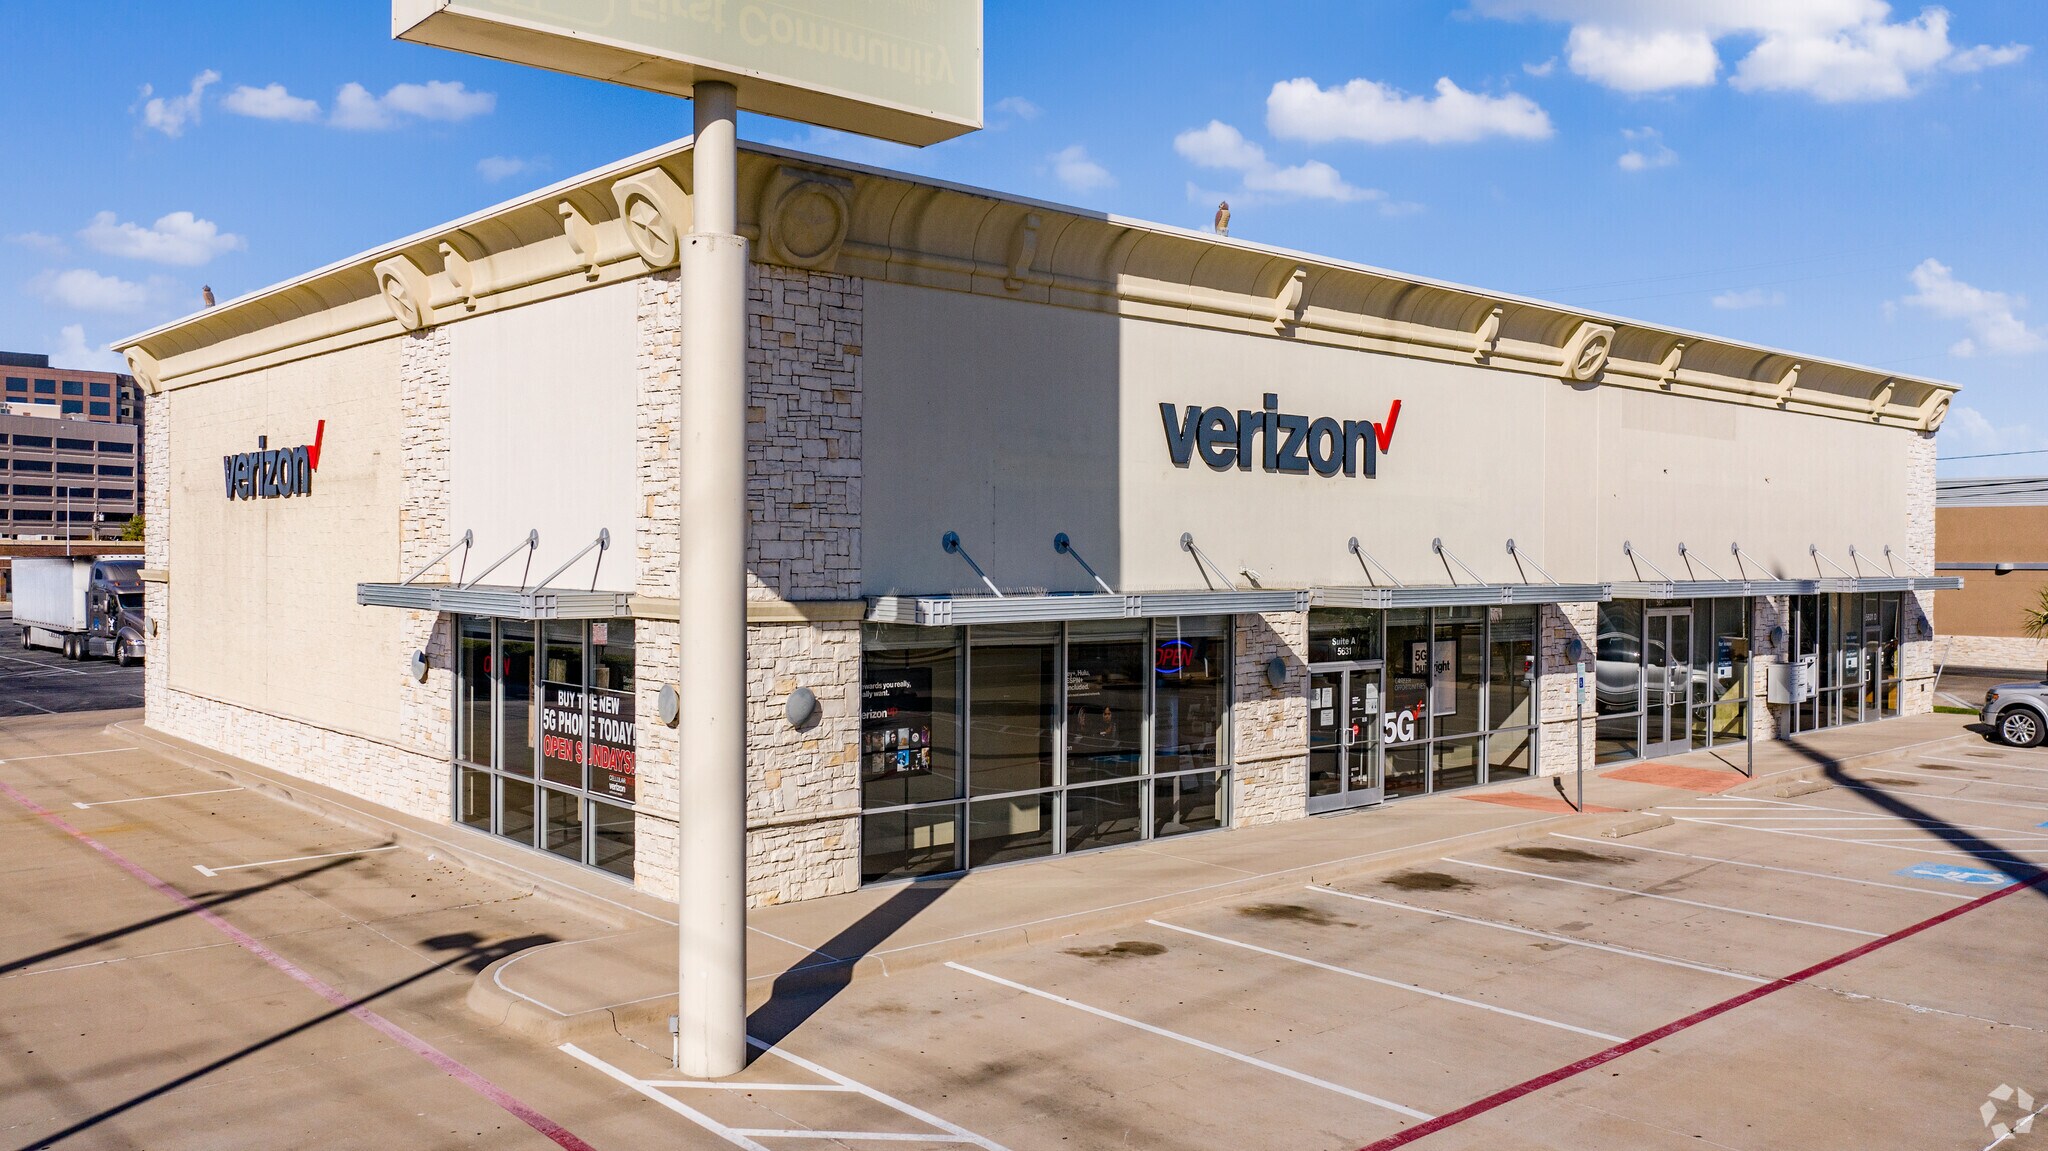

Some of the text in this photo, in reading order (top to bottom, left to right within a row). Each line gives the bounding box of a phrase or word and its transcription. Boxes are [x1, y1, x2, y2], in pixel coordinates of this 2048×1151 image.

[1159, 392, 1377, 479] verizon
[223, 435, 312, 501] verizon
[1331, 637, 1356, 646] Suite A
[1337, 647, 1352, 656] 5631
[1155, 648, 1194, 668] OPEN
[557, 689, 620, 715] BUY TE NEW
[543, 708, 556, 731] 5G
[1384, 710, 1415, 744] 5G
[543, 734, 636, 775] OPEN SNDAYS!
